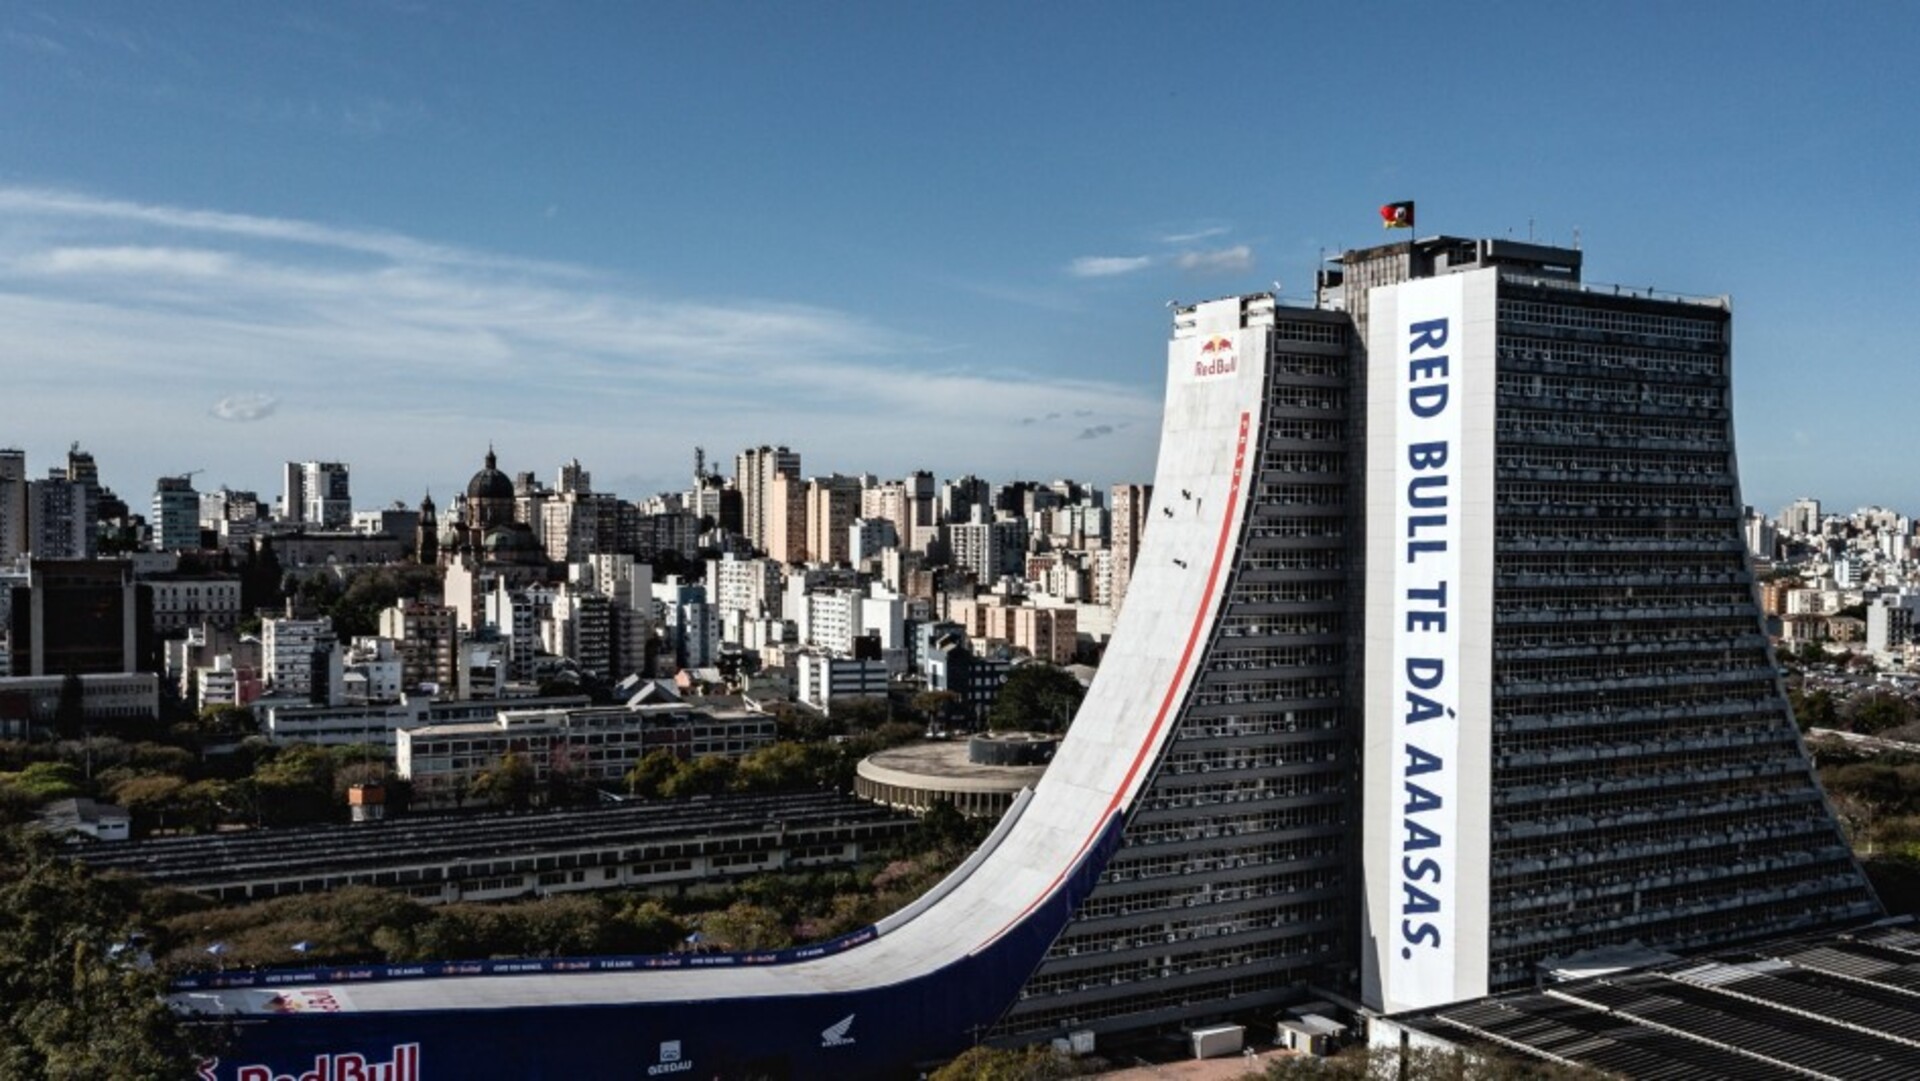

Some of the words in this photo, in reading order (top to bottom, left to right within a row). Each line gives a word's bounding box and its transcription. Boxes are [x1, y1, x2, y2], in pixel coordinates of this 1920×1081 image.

[1194, 358, 1216, 376] Red
[1216, 355, 1238, 374] Bull
[1408, 317, 1449, 419] RED
[1407, 440, 1449, 564] BULL
[1406, 580, 1448, 633] TE
[1405, 657, 1456, 725] DÁ
[1401, 743, 1444, 960] AAASAS.
[647, 1060, 692, 1076] GERDAU
